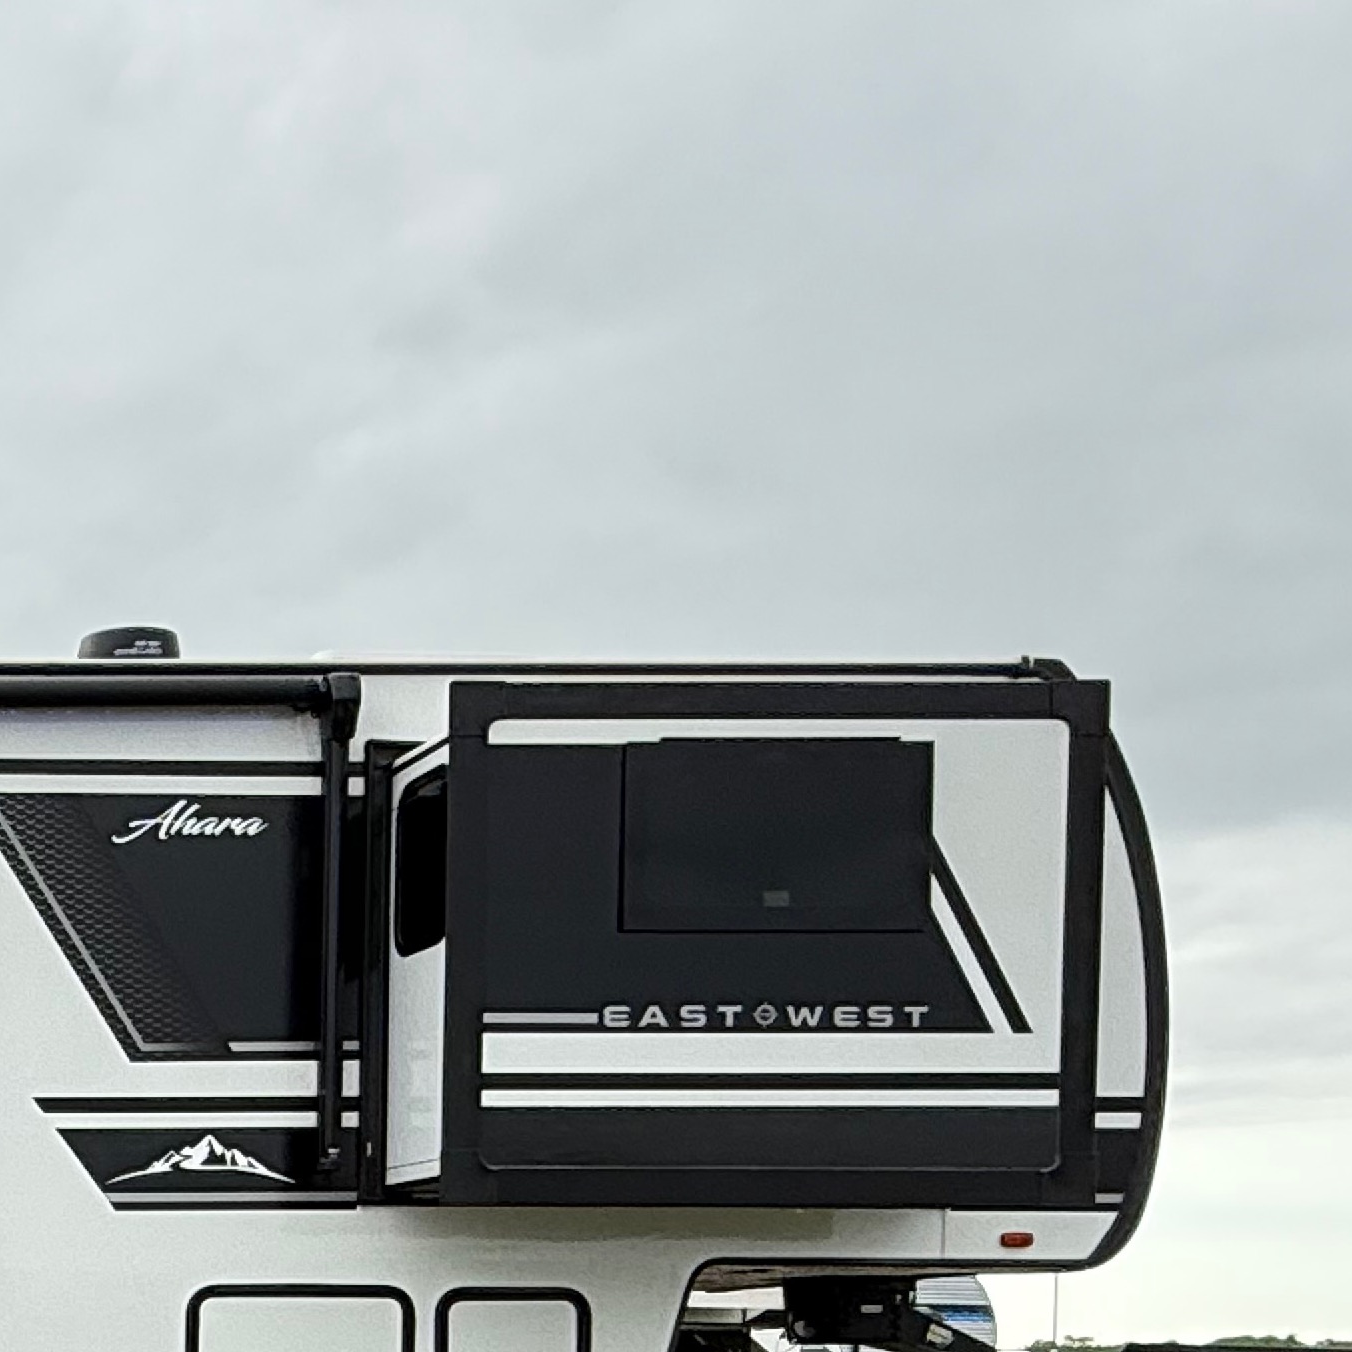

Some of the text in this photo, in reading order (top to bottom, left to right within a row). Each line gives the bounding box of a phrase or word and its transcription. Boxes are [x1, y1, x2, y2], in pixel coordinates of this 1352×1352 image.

[111, 799, 269, 844] Ahara
[602, 1004, 930, 1028] EAST WEST
